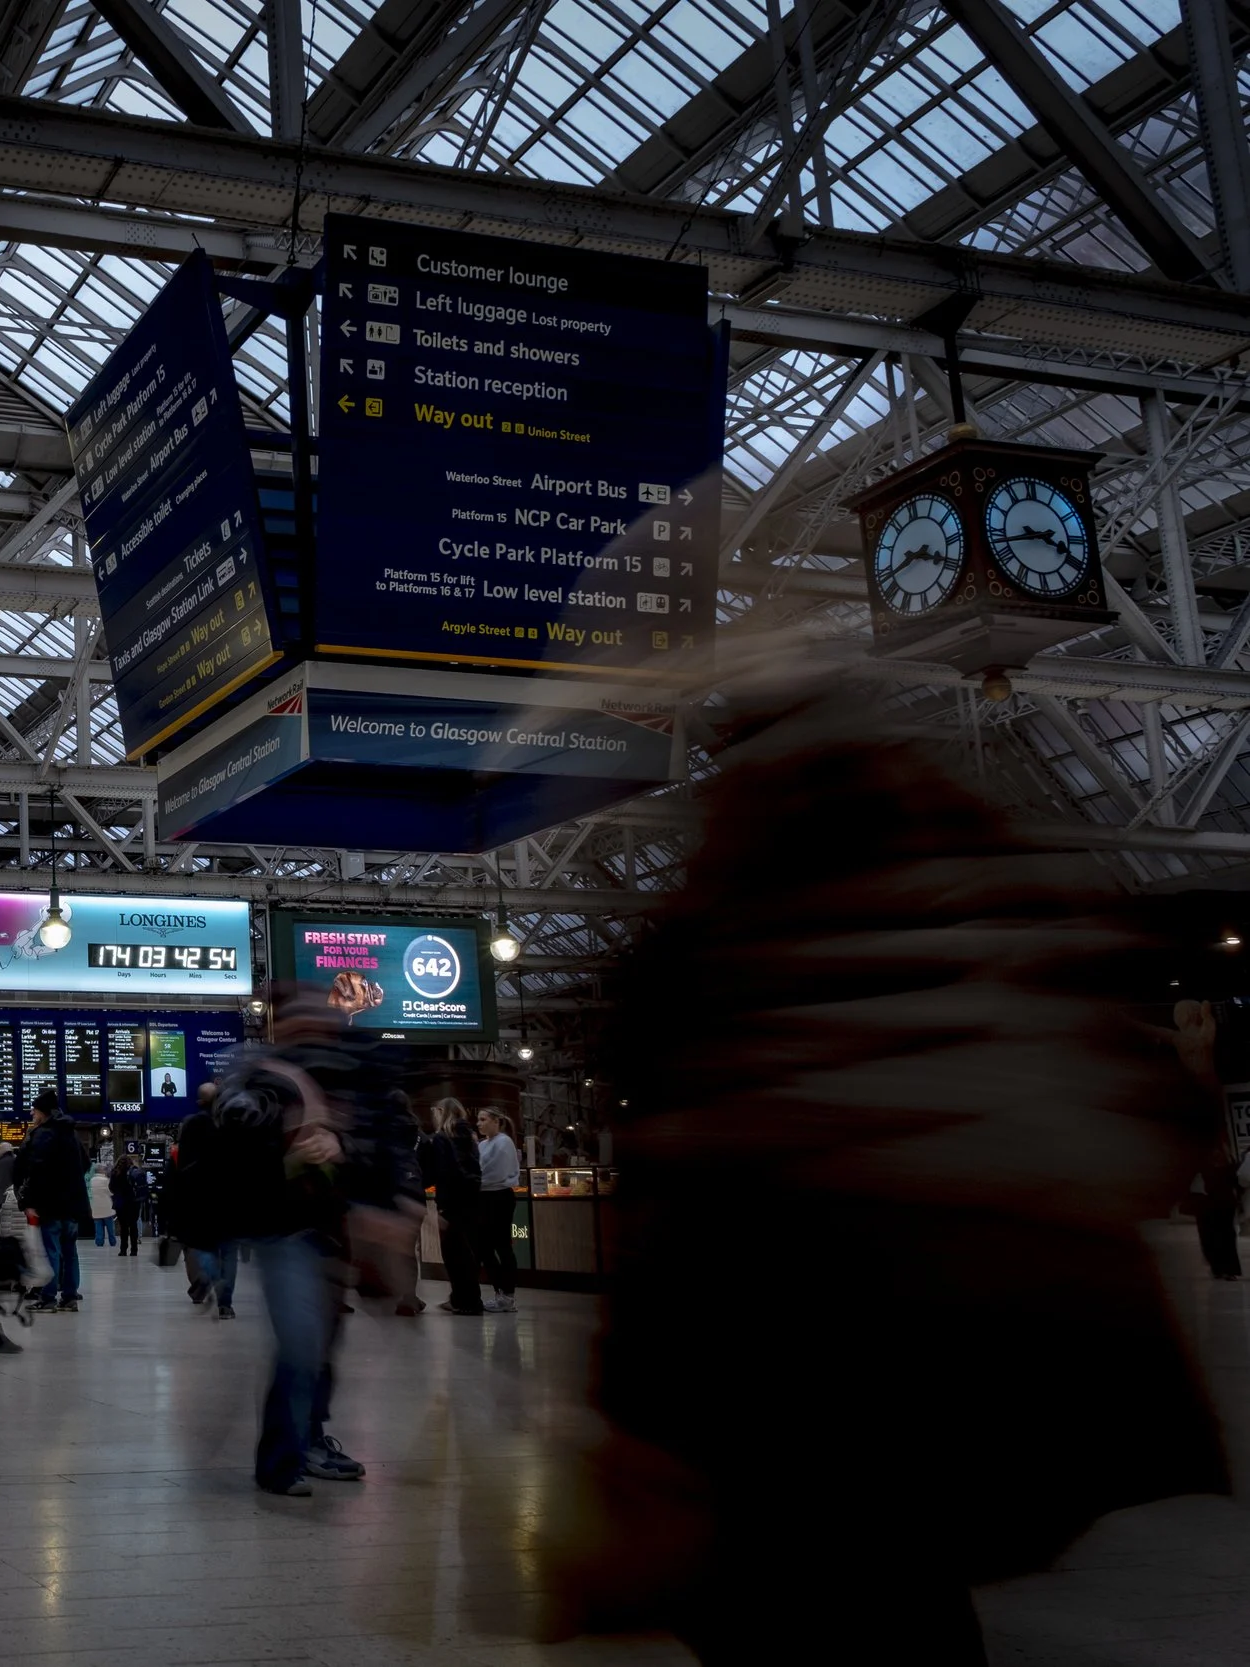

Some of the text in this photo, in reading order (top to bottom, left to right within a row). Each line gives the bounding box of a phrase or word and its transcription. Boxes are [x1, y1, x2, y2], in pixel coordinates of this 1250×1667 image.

[417, 254, 568, 293] Customer lounge
[416, 291, 611, 336] Left luggage Lost property
[413, 328, 580, 366] Toilets and showers
[93, 372, 130, 423] Left luggage
[414, 366, 568, 401] Station reception
[95, 364, 166, 458] Cycle Park Platform 15
[414, 403, 590, 443] Way out Union Street
[105, 421, 156, 484] Low level station
[150, 423, 188, 472] Airport Bus
[445, 471, 627, 499] Waterloo Street Airport Bus
[121, 483, 195, 560] Accessible toilet Changing
[452, 508, 626, 535] Platform 15 NCP Car Park
[183, 541, 212, 573] Tickets
[439, 538, 642, 572] Cycle Park Platform 15
[376, 581, 475, 598] to Platforms 16 & 17
[384, 568, 475, 586] Platform 15 for lift
[483, 580, 626, 609] Low level station
[113, 576, 215, 672] Taxis and Glasgow Station Link
[191, 608, 225, 646] Way out
[442, 621, 623, 646] Argyle Street Way out
[196, 643, 231, 680] Way out
[267, 678, 304, 709] NetworkRail
[331, 715, 627, 752] Welcome to Glasgow Central Station
[165, 736, 280, 815] Welcome to Glasgow Central Station
[120, 913, 207, 928] LONGINES
[305, 932, 386, 946] FRESH START
[323, 946, 369, 956] FOR YOUR
[99, 945, 235, 969] 174 03 42 54
[316, 956, 378, 969] FINANCES
[412, 957, 452, 977] 642
[413, 1001, 466, 1012] ClearScore
[511, 1223, 528, 1239] Best
